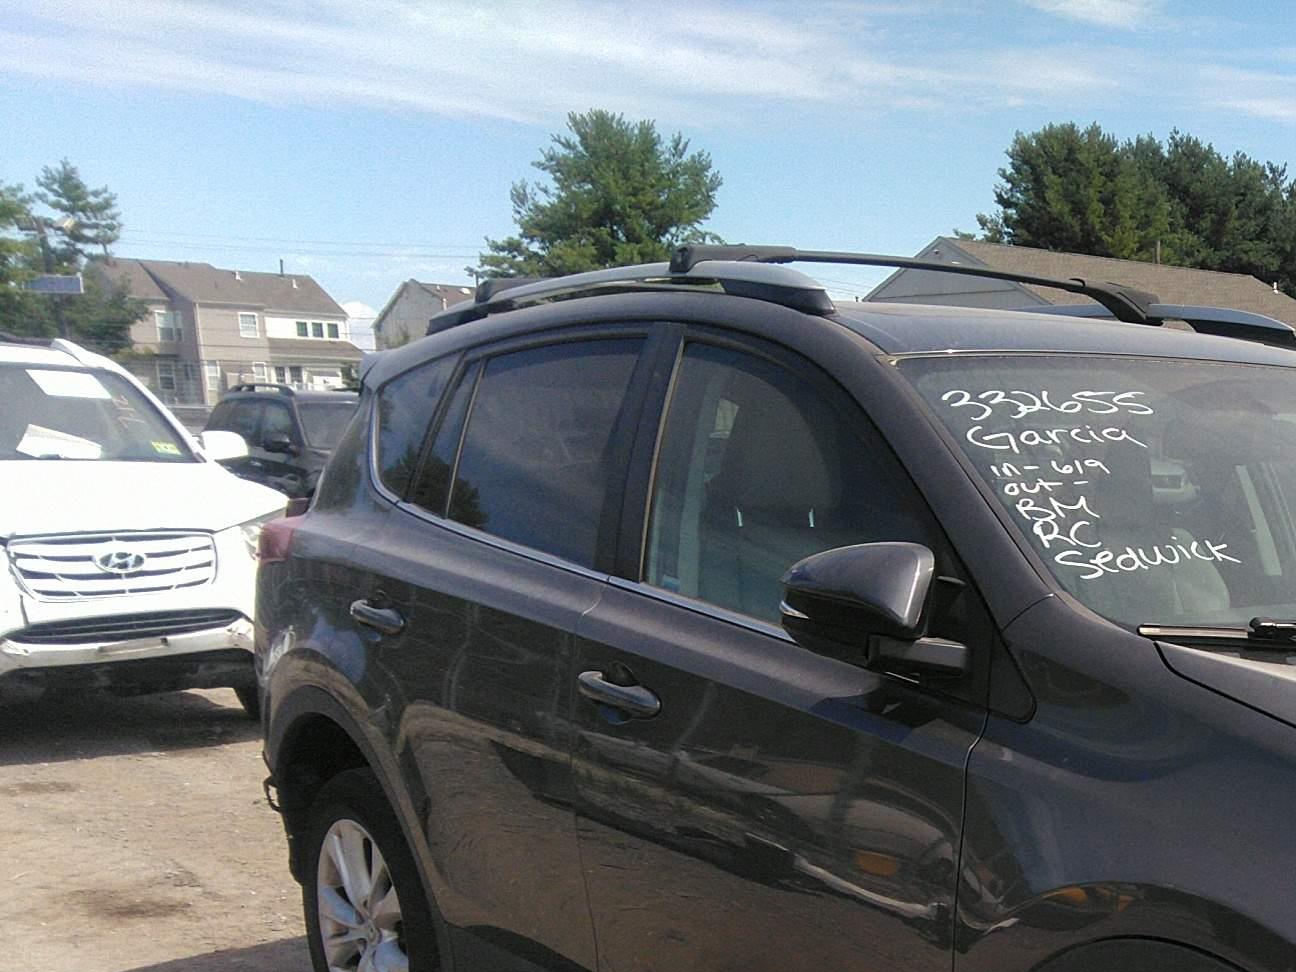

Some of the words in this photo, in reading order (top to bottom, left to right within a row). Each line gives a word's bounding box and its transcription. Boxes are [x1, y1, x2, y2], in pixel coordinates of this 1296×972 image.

[941, 390, 1154, 421] 332655
[966, 425, 1148, 454] Garcia
[1050, 459, 1111, 474] 619
[1015, 495, 1100, 521] BM
[1032, 520, 1102, 548] RC
[1054, 536, 1242, 580] Sedwick
